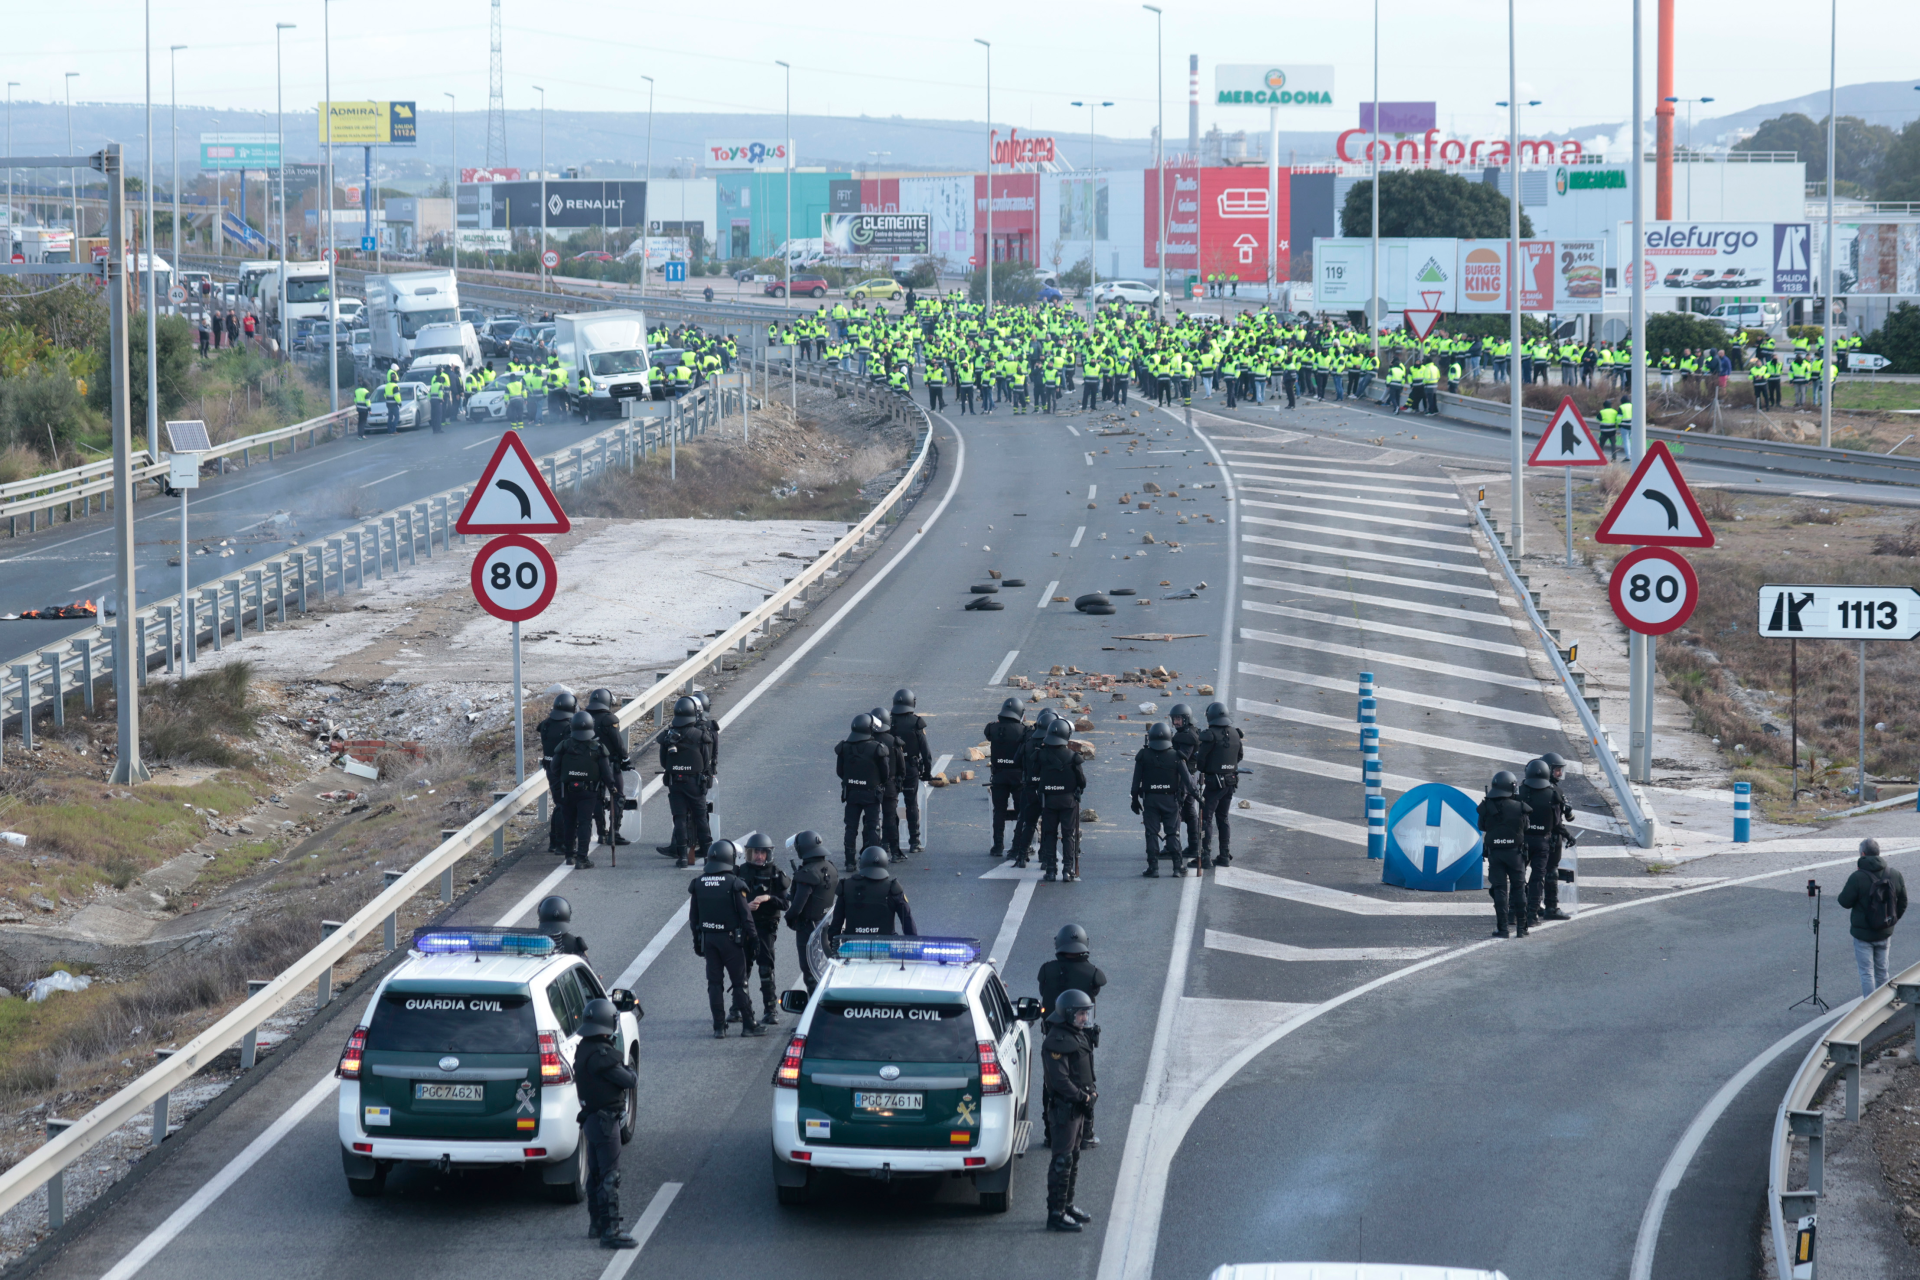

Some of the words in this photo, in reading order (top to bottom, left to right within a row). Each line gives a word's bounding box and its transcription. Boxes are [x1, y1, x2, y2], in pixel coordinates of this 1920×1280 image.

[1217, 90, 1332, 104] MERCADONA
[330, 107, 382, 116] ADMIRAL
[990, 128, 1055, 168] Conforama
[1336, 128, 1582, 168] Conforama
[566, 200, 626, 209] RENAULT
[862, 217, 926, 230] CLEMENTE
[1529, 244, 1543, 254] 1112
[1544, 244, 1552, 254] A
[544, 255, 558, 263] 100
[1465, 265, 1501, 275] BURGER
[1465, 277, 1501, 292] KING
[1777, 274, 1808, 283] SALIDA
[490, 562, 538, 590] 80
[1629, 574, 1679, 603] 80
[1838, 601, 1897, 630] 1113
[406, 1000, 465, 1011] GUARDIA
[469, 1000, 503, 1012] CIVIL
[844, 1007, 904, 1019] GUARDIA
[908, 1009, 942, 1021] CIVIL
[1807, 1218, 1815, 1228] 2
